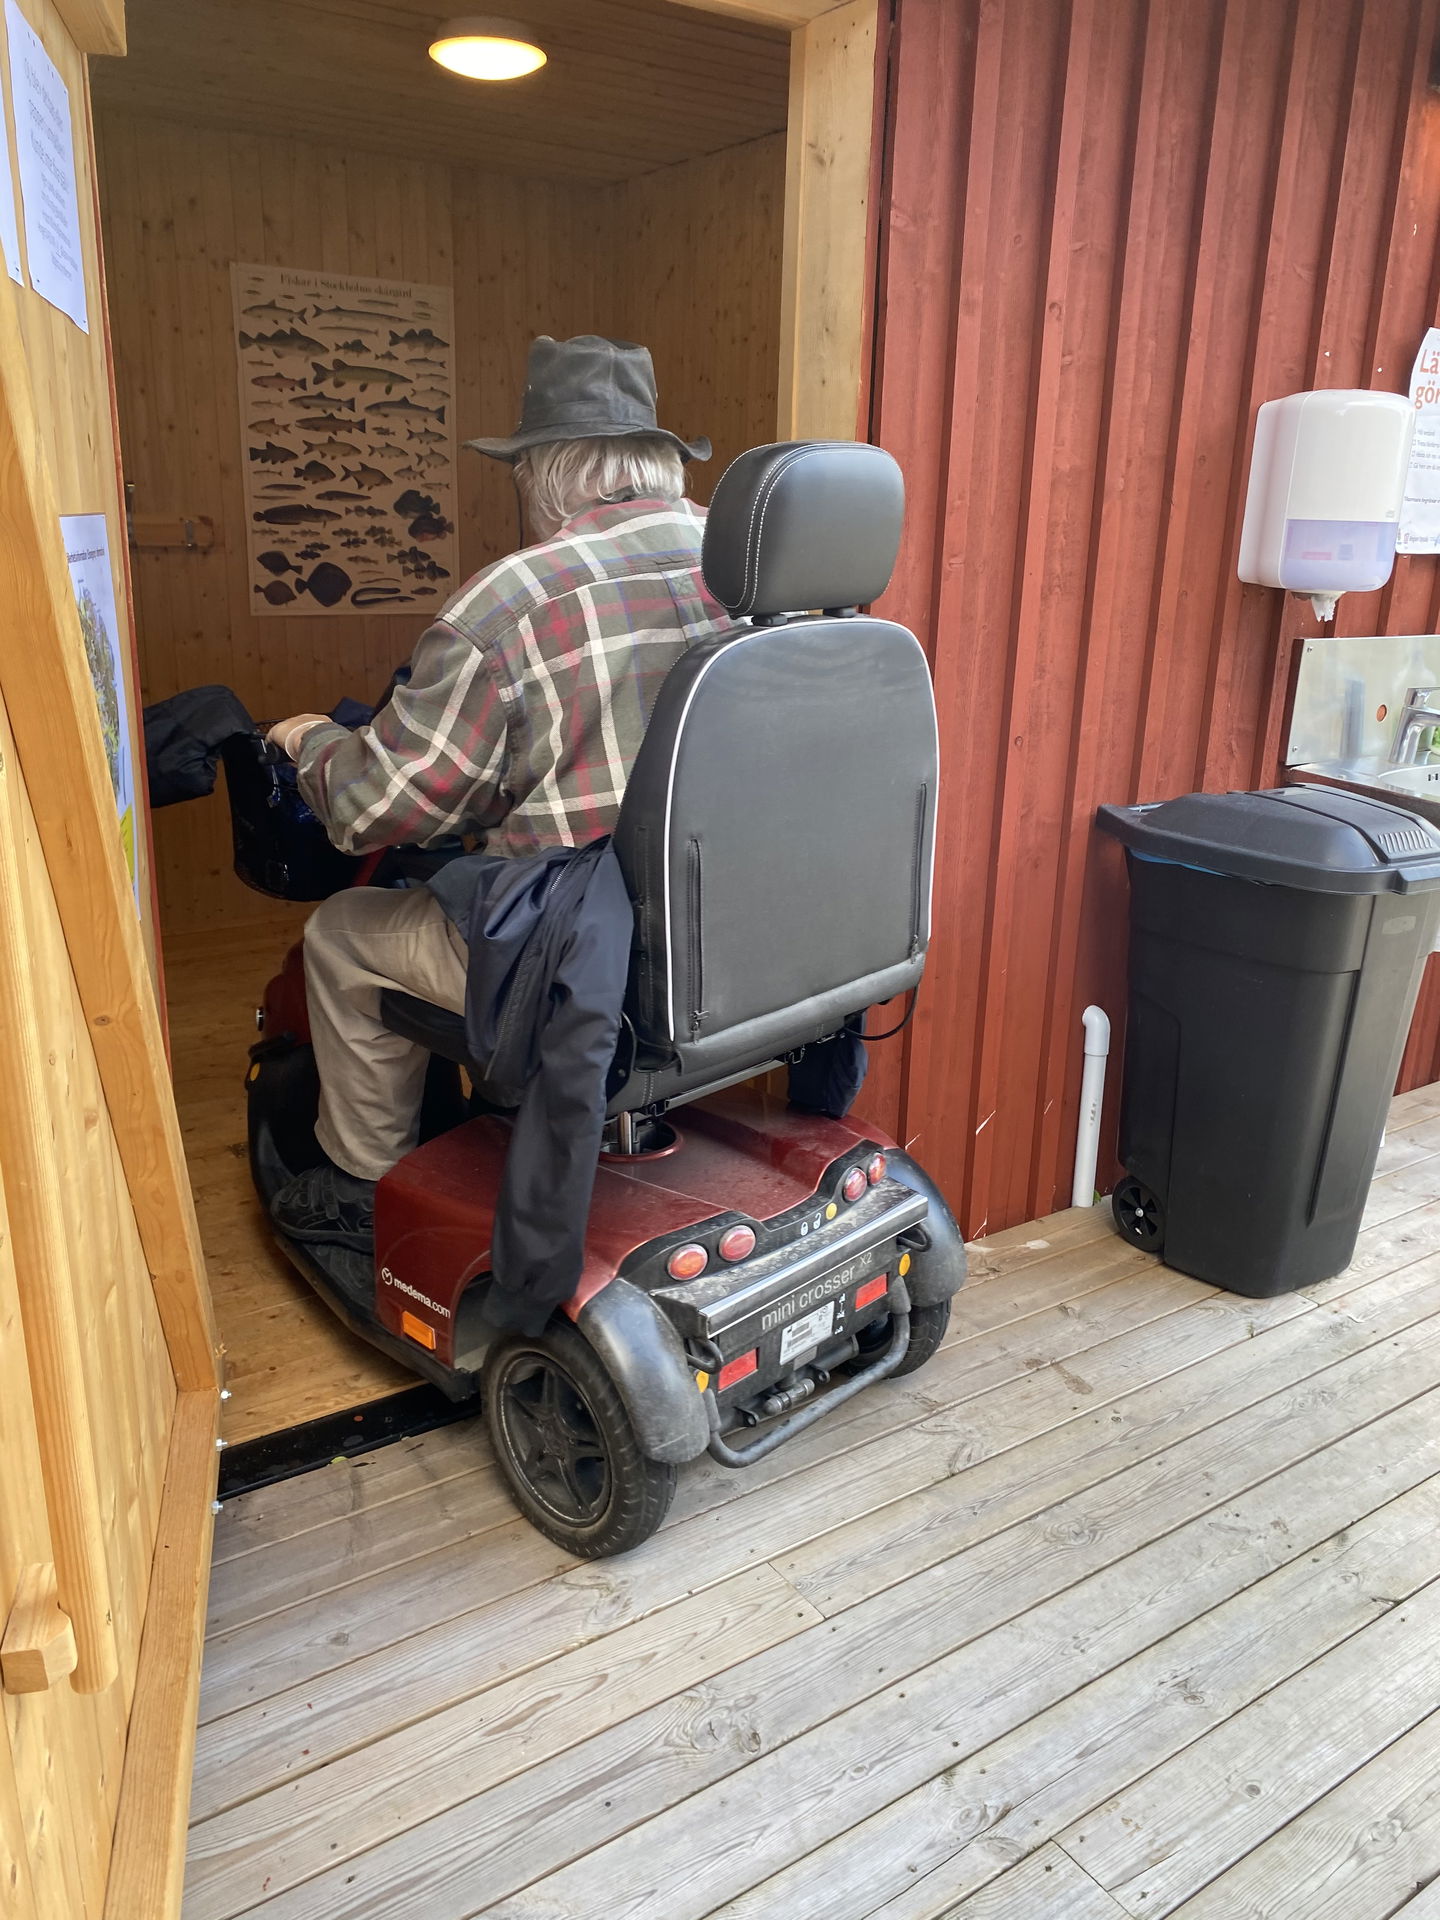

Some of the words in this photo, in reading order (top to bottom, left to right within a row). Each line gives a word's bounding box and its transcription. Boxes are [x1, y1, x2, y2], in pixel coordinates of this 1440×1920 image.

[280, 273, 311, 288] Fiskar
[320, 279, 372, 293] Stockholms
[374, 284, 412, 298] skärgård
[393, 1278, 451, 1319] medema.com
[762, 1295, 795, 1330] mini
[799, 1265, 855, 1308] crosser
[859, 1252, 873, 1265] X2
